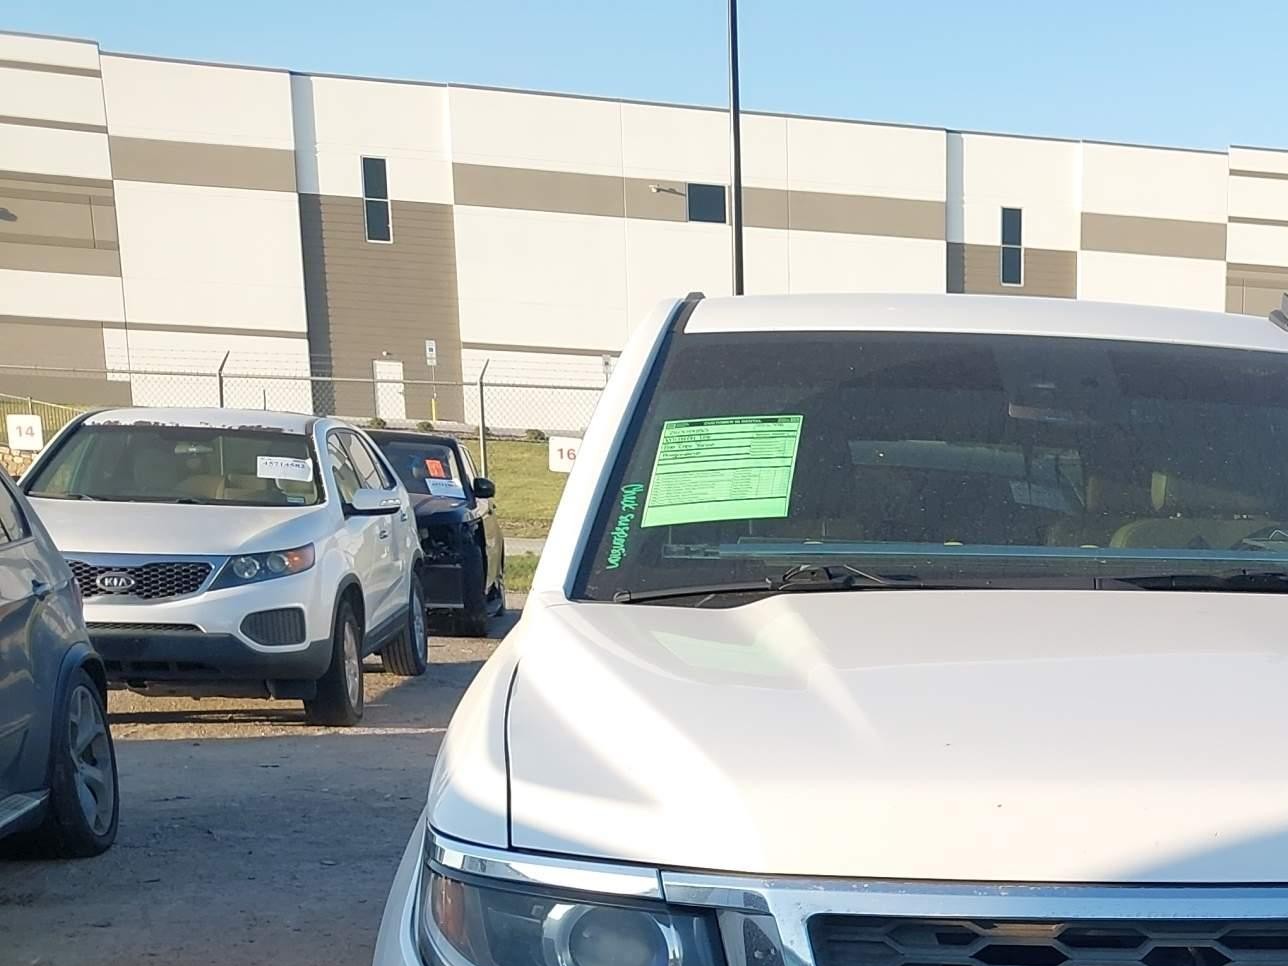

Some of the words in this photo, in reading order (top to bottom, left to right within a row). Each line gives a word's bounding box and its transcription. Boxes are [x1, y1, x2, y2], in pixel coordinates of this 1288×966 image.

[16, 425, 35, 437] 14
[557, 448, 577, 460] 16
[104, 577, 127, 587] KIA
